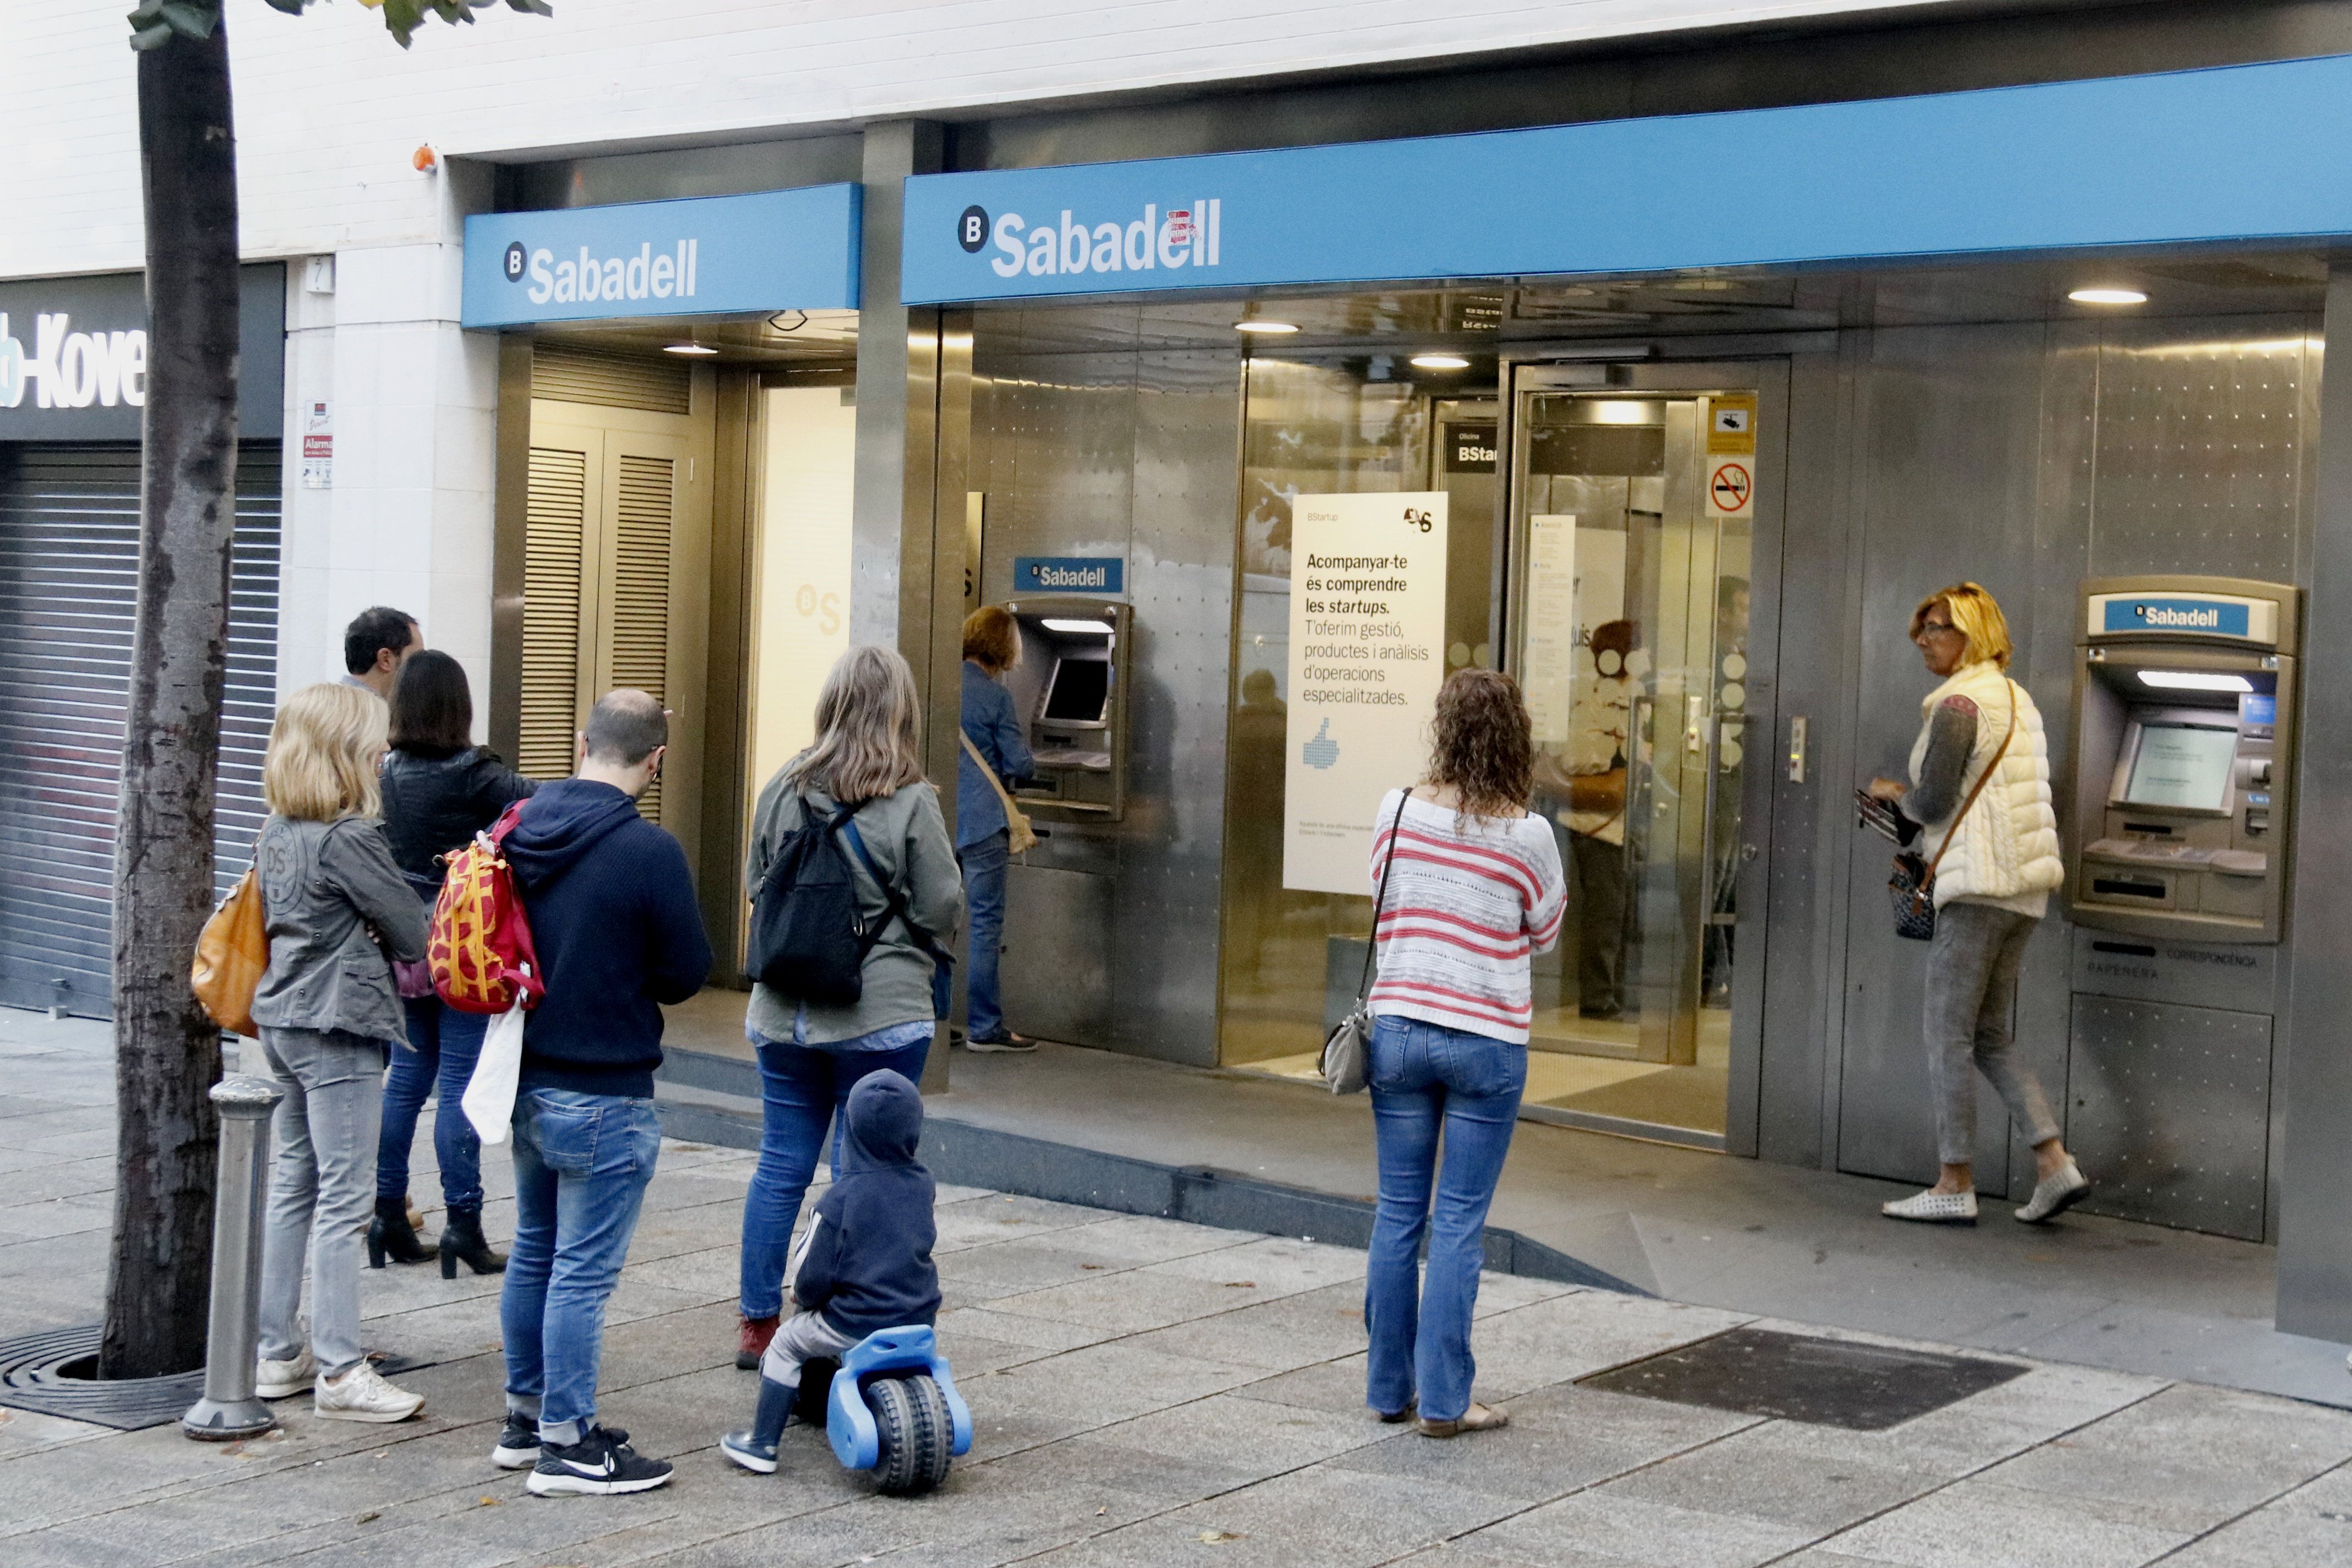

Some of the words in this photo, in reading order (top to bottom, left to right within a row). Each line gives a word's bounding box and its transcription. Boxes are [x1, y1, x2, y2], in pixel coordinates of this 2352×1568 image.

[992, 199, 1221, 277] Sabadell
[528, 239, 697, 304] Sabadell
[1308, 513, 1338, 522] BStartup
[1306, 553, 1408, 572] Acompanyar-te
[1040, 566, 1106, 587] Sabadell
[1306, 575, 1321, 590] és
[1326, 576, 1407, 594] comprendre
[1305, 597, 1324, 612] les
[1329, 599, 1390, 618] startups.
[2146, 606, 2218, 627] Sabadell
[1305, 619, 1356, 635] T'oferim
[1360, 622, 1404, 640] gestió,
[1305, 643, 1368, 660] productes
[1373, 644, 1376, 658] i
[1380, 644, 1429, 660] anàlisis
[1304, 664, 1385, 683] d'operacions
[1303, 688, 1408, 705] especialitzades.
